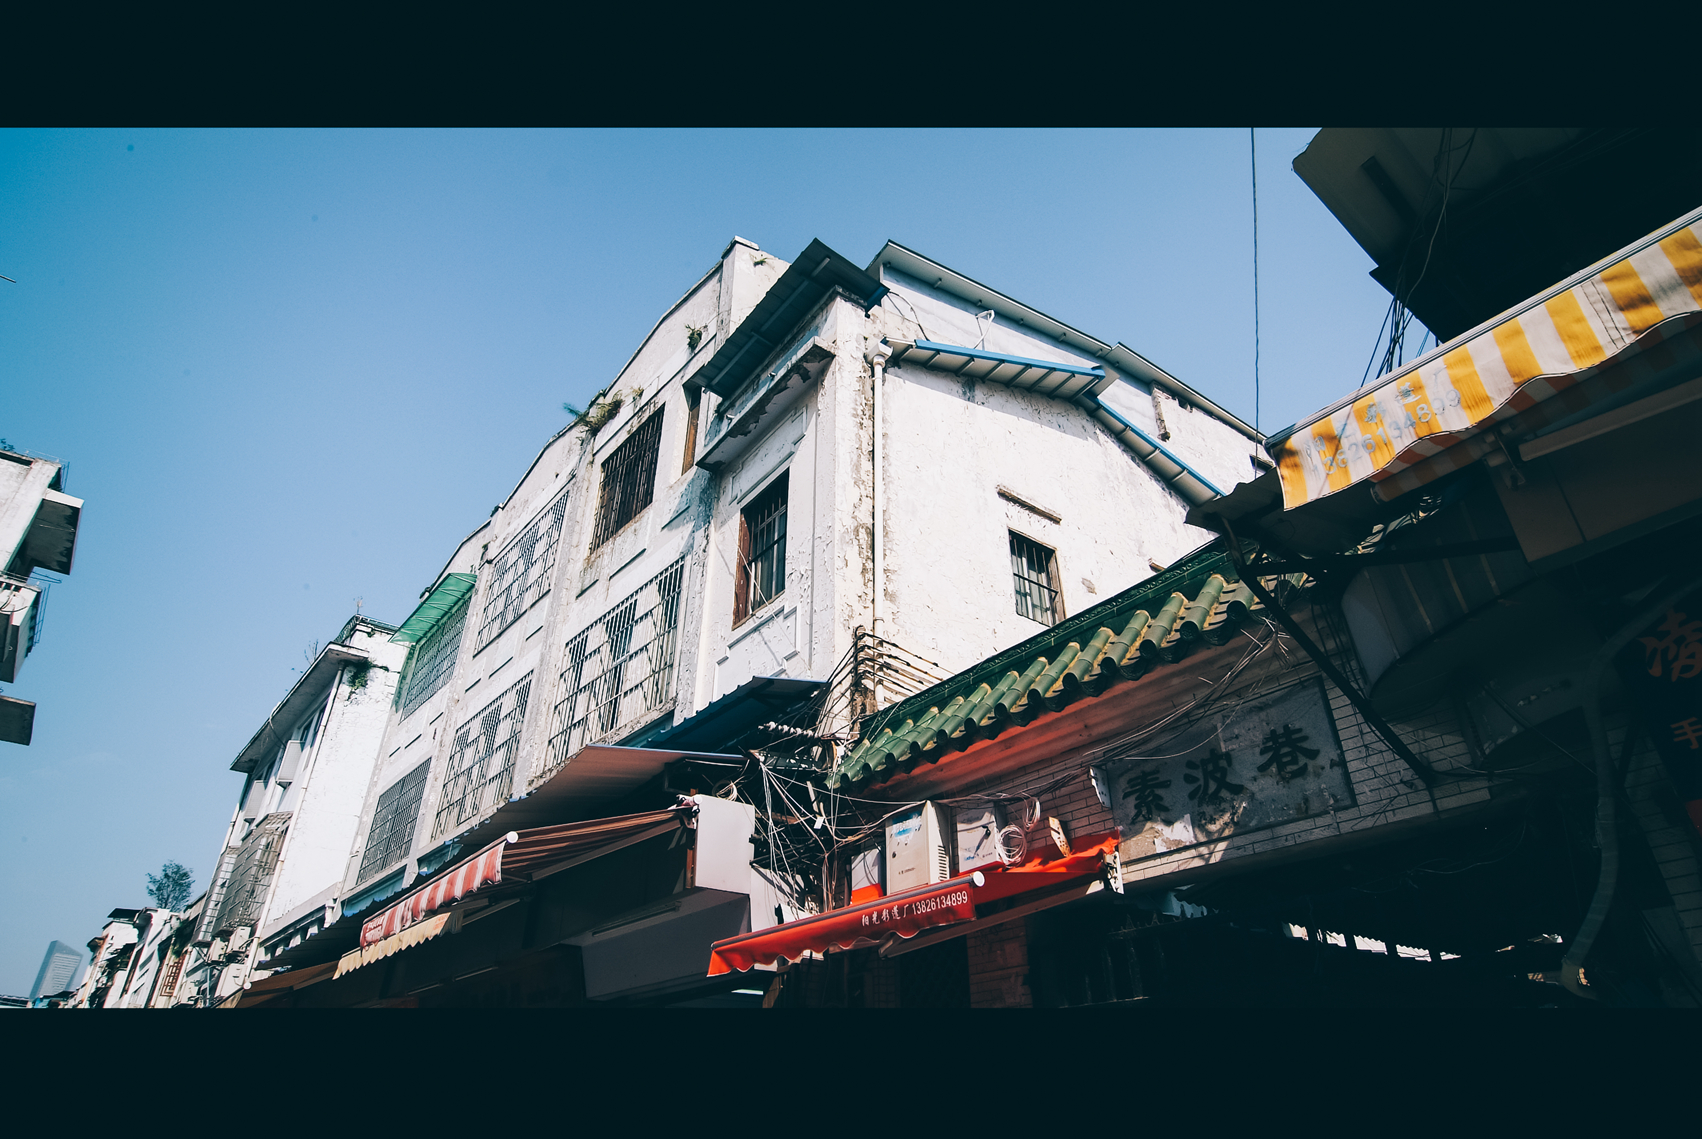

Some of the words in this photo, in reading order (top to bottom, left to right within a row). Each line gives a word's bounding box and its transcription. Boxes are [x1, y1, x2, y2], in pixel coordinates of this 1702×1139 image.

[1312, 389, 1461, 480] 13826134899
[1122, 724, 1320, 824] 素波巷
[912, 890, 968, 916] 13826134899
